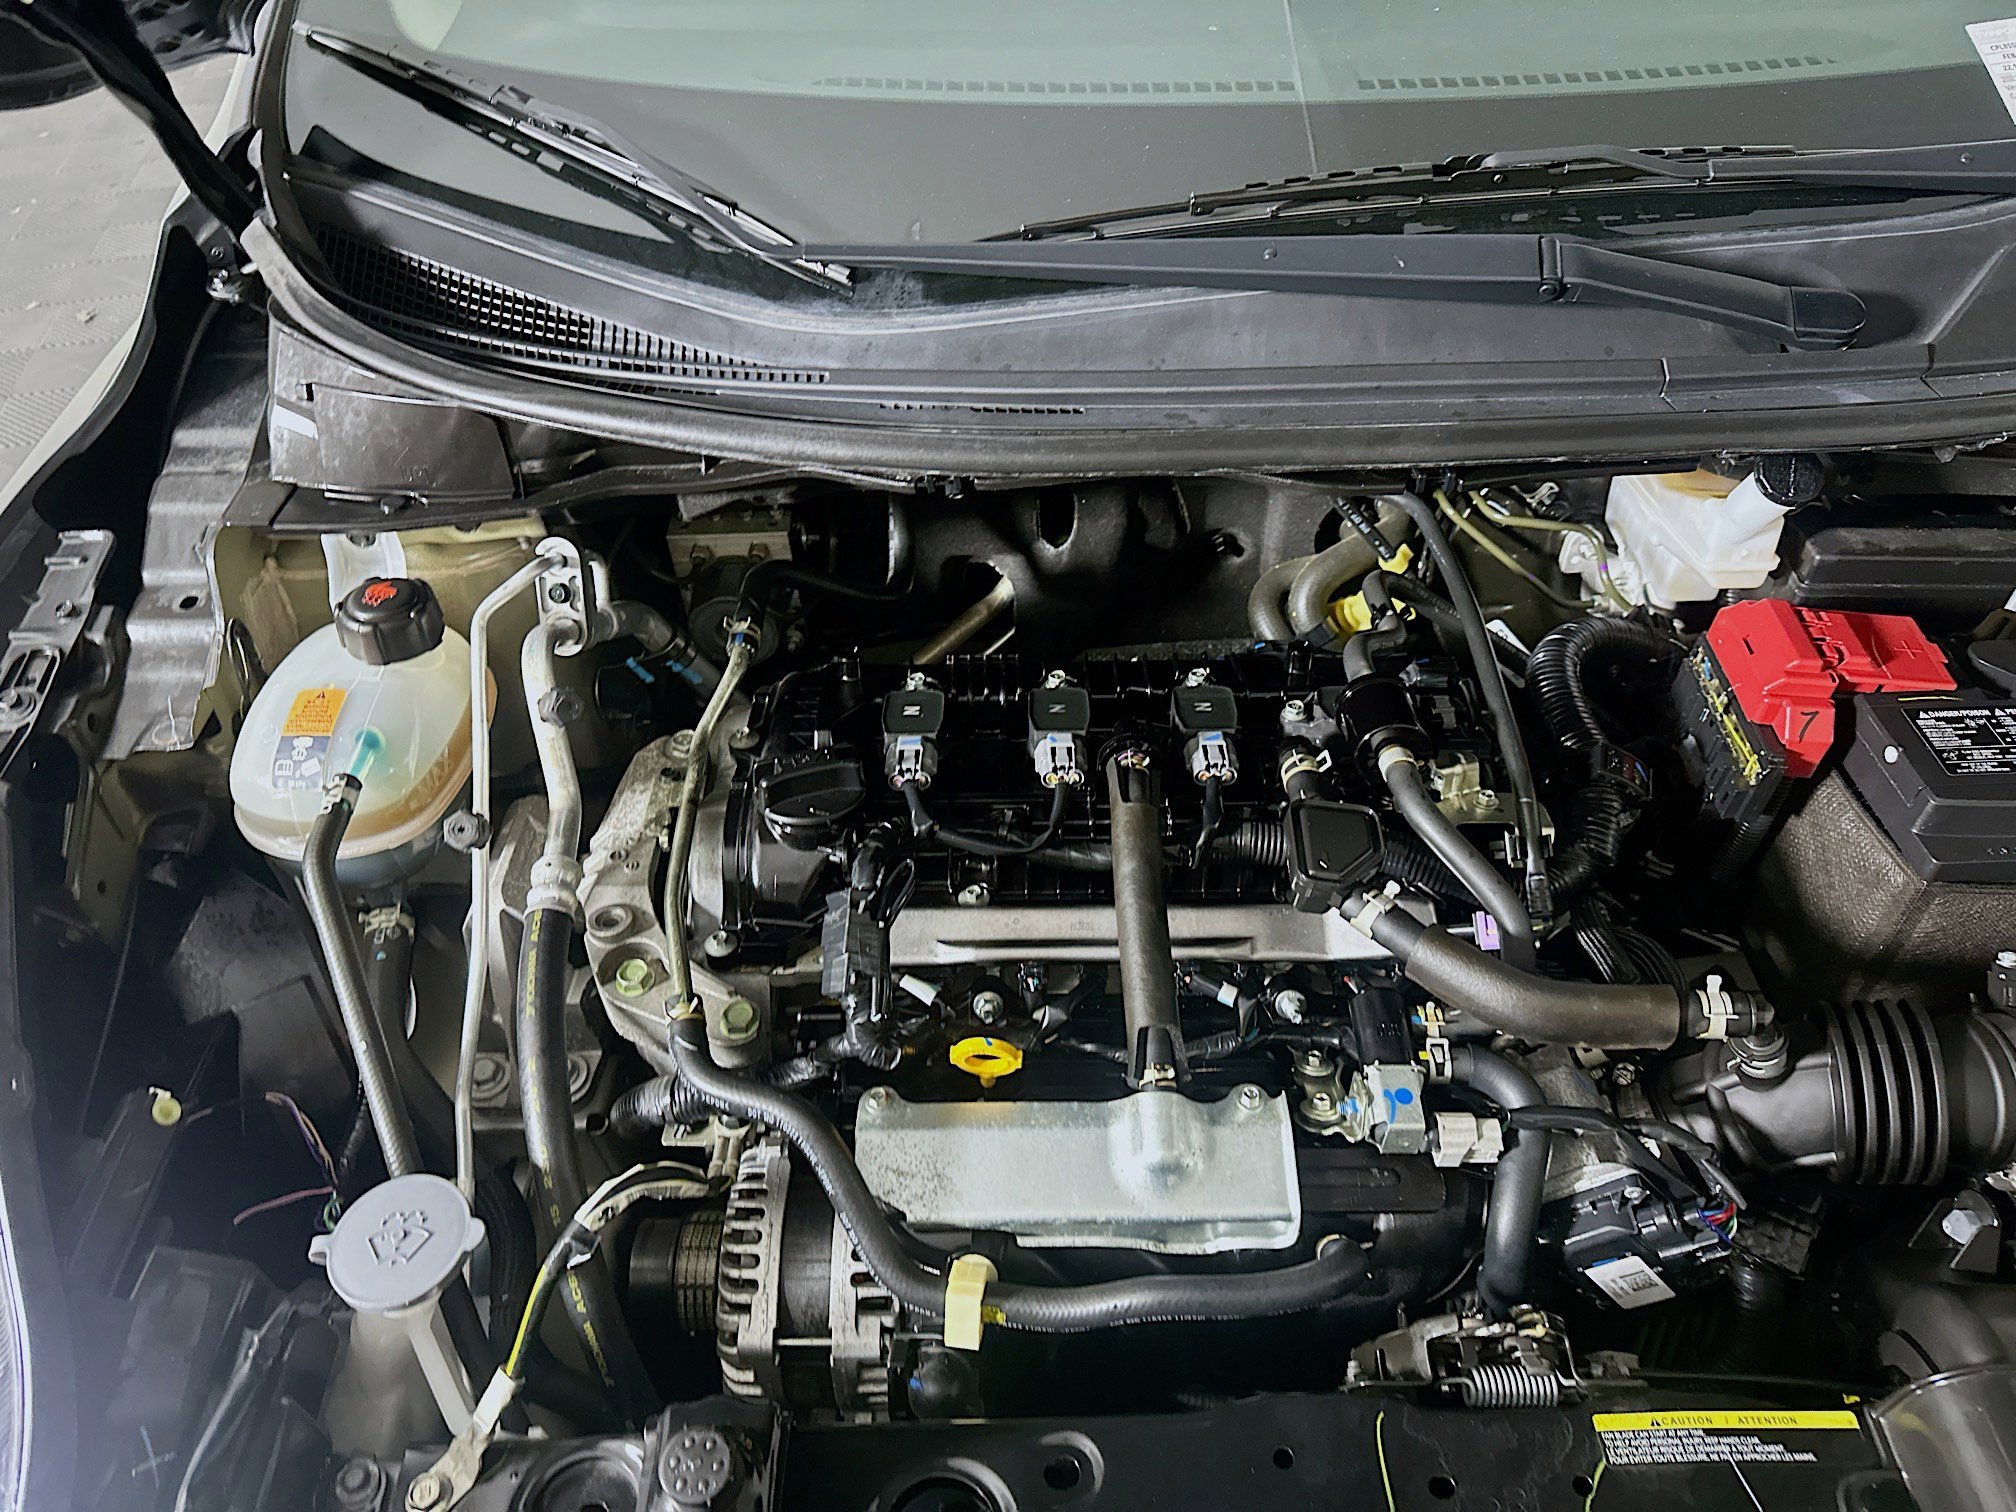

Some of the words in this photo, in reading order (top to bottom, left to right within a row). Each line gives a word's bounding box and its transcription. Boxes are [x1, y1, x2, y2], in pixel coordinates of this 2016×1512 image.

[1799, 710, 1819, 743] 7
[1661, 1416, 1714, 1426] CAUTION
[1737, 1415, 1798, 1425] ATTENTION
